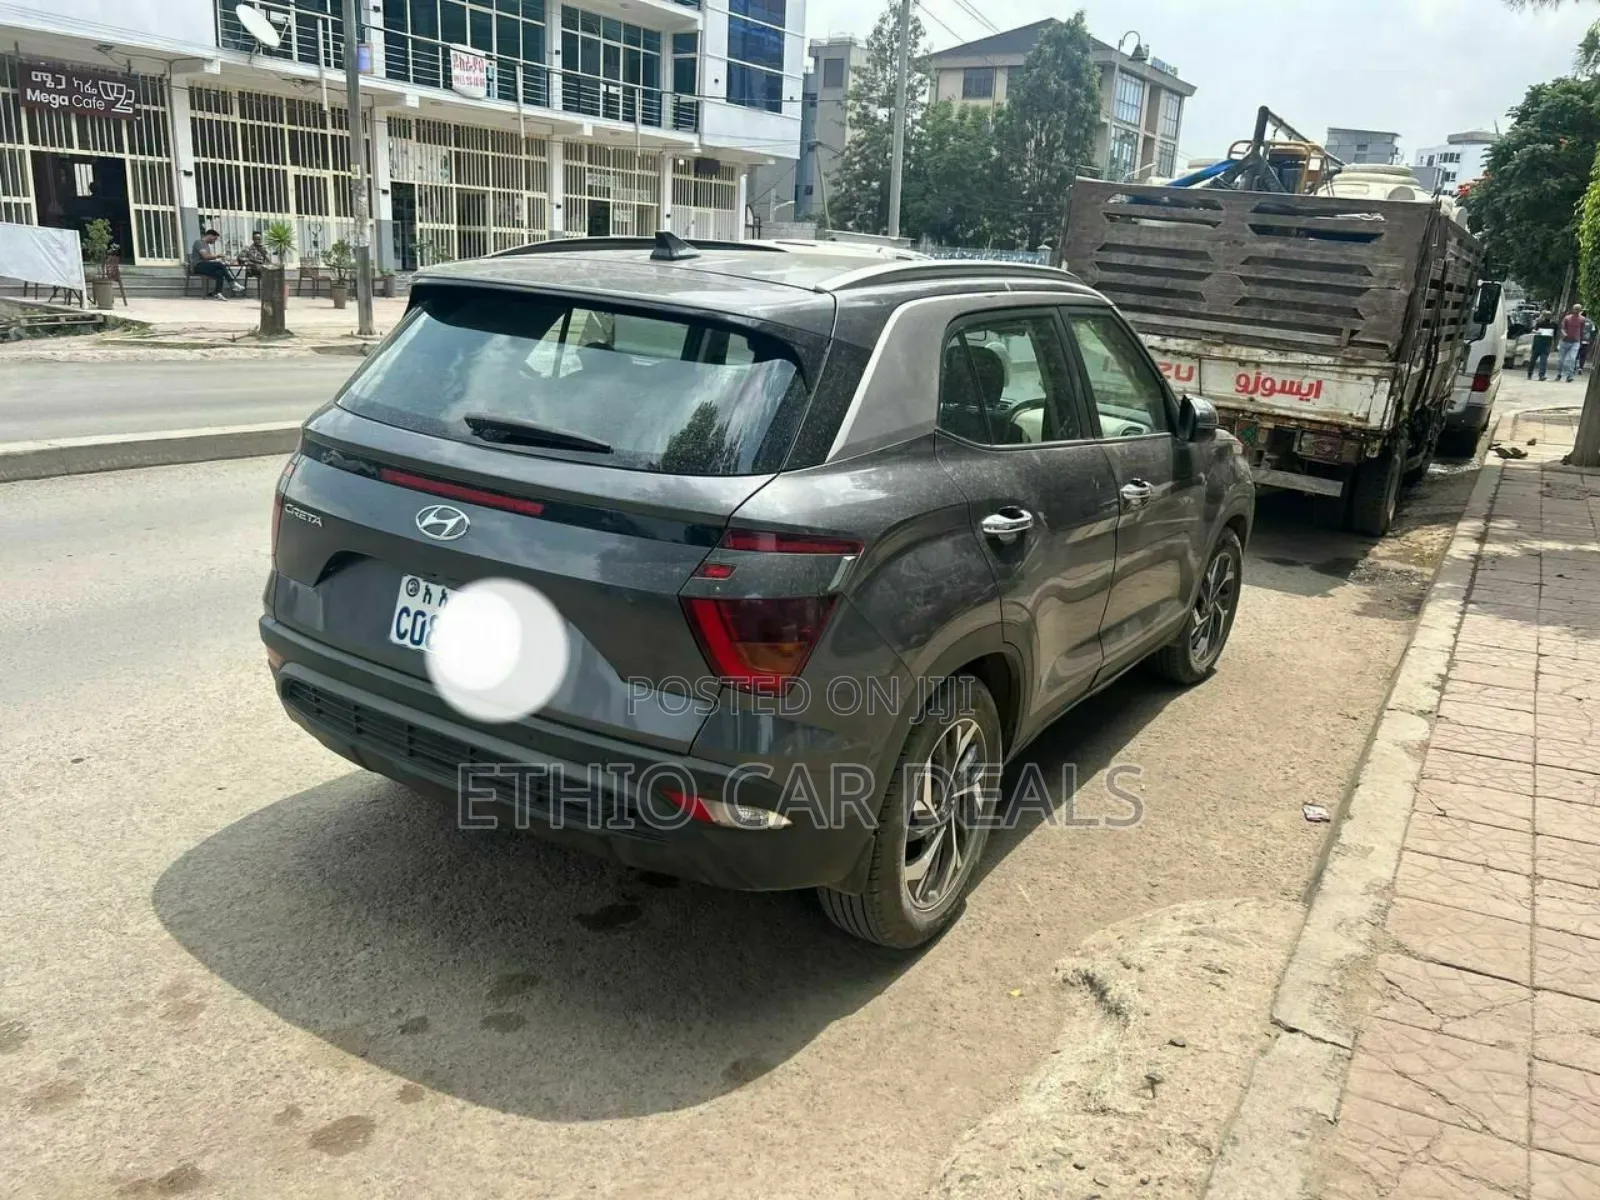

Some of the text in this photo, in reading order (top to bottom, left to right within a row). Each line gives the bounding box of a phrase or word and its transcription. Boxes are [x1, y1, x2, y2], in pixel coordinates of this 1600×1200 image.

[26, 88, 105, 110] Mega Cafe
[284, 503, 323, 527] CRETA
